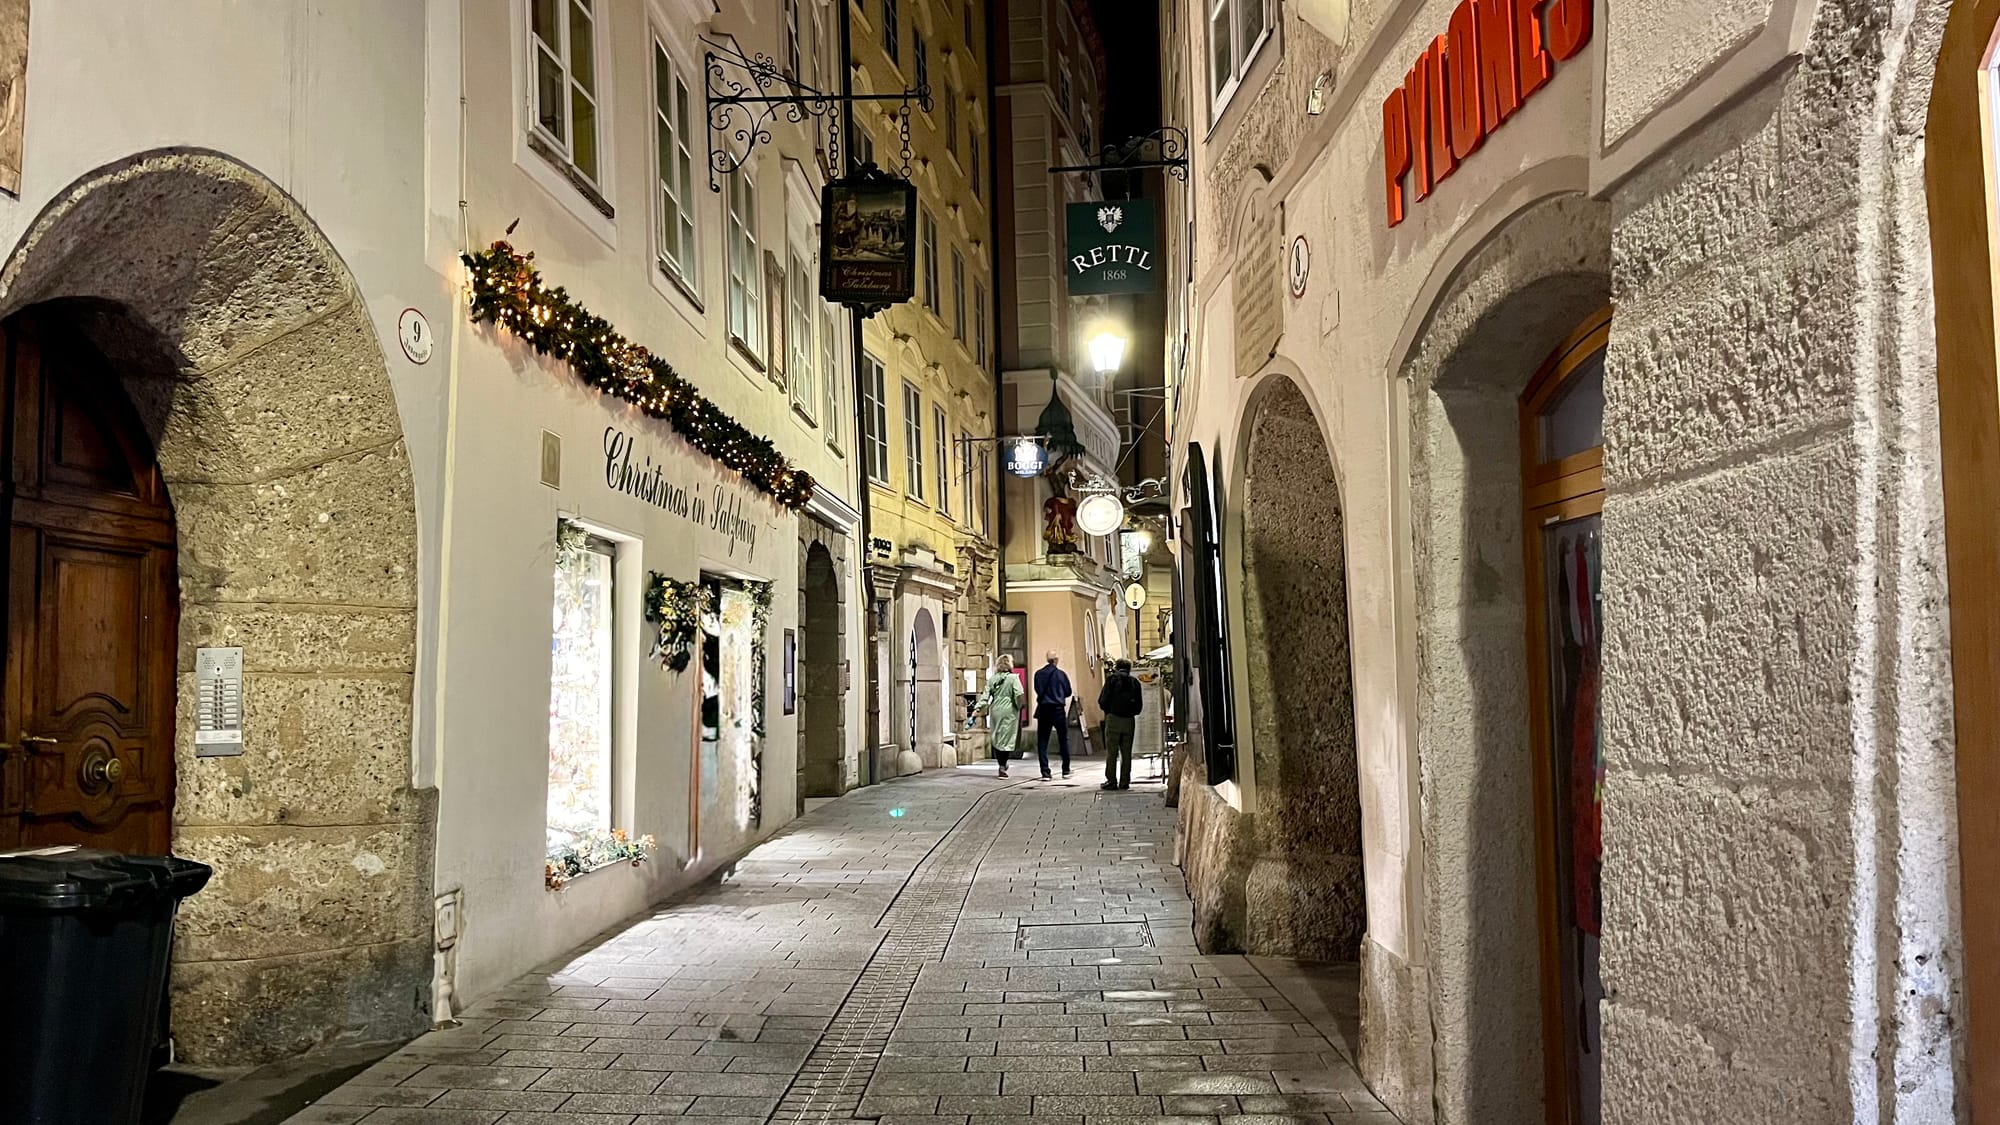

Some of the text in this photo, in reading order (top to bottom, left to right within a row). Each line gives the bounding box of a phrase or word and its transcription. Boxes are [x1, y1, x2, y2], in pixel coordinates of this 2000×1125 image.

[1071, 244, 1152, 274] RETTL
[1295, 243, 1301, 277] 8
[841, 264, 892, 277] Christmas
[1103, 269, 1127, 281] 1868
[842, 278, 891, 292] Salzburg
[413, 320, 421, 343] 9
[1007, 461, 1043, 471] BOGGI
[604, 426, 757, 564] Christmas in Salzburg
